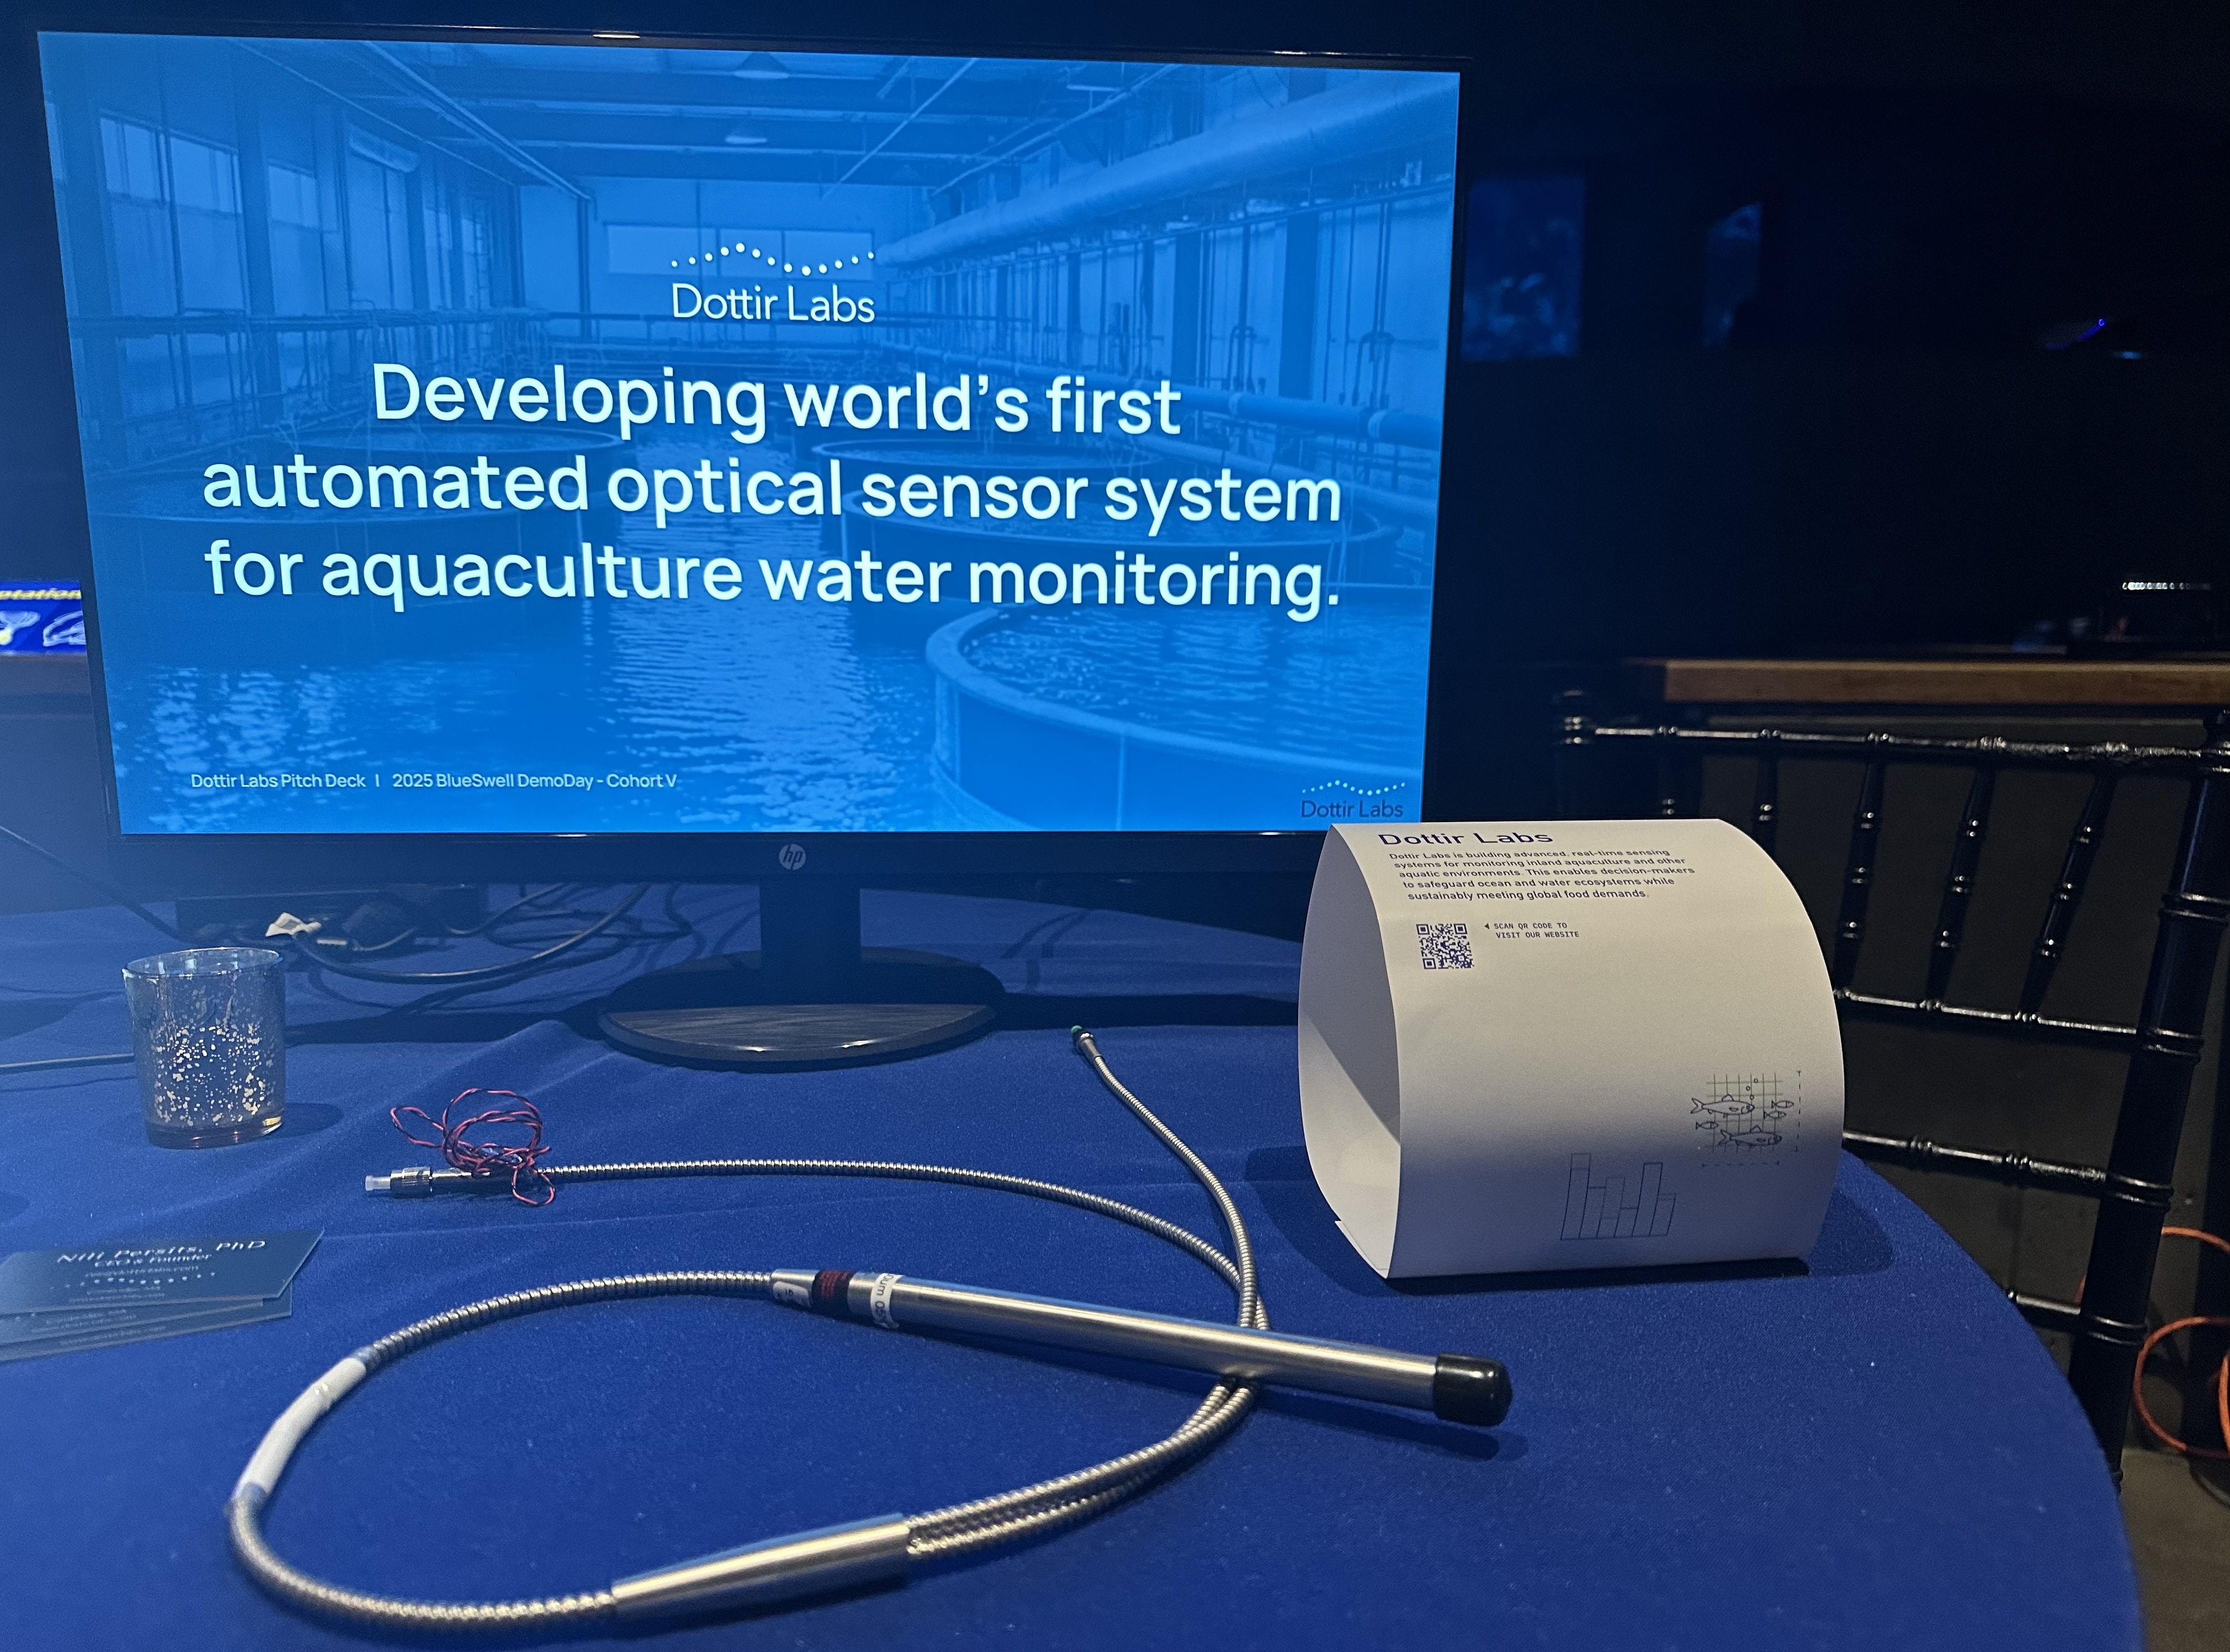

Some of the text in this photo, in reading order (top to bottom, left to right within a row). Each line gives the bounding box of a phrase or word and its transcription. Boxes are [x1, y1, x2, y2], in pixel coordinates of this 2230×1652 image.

[673, 283, 874, 322] Dottir Labs
[374, 364, 765, 443] Developing
[1046, 377, 1181, 434] first
[204, 455, 1339, 536] automated optical sensor system
[205, 540, 1338, 622] for aquaculture water monitoring.
[191, 774, 237, 787] Dottir
[240, 774, 278, 787] Labs
[281, 774, 322, 787] Pitch
[325, 774, 366, 787] Deck
[393, 774, 433, 787] 2025
[437, 774, 513, 787] BlueSwell
[518, 774, 593, 791] DemoDay
[607, 774, 663, 787] Cohort
[666, 774, 677, 787] V
[1302, 799, 1403, 817] Dottir Labs
[1378, 832, 1553, 845] Dottir Labs
[781, 844, 805, 871] hp
[1462, 859, 1525, 868] monitoring
[1564, 859, 1631, 867] aquaculture
[1417, 880, 1475, 889] safeguard
[1574, 878, 1641, 887] ecosystems
[1408, 891, 1473, 901] sustainably
[1476, 890, 1524, 901] meeting
[1526, 890, 1563, 901] global
[1593, 889, 1650, 898] demands.
[215, 1240, 266, 1252] PhD
